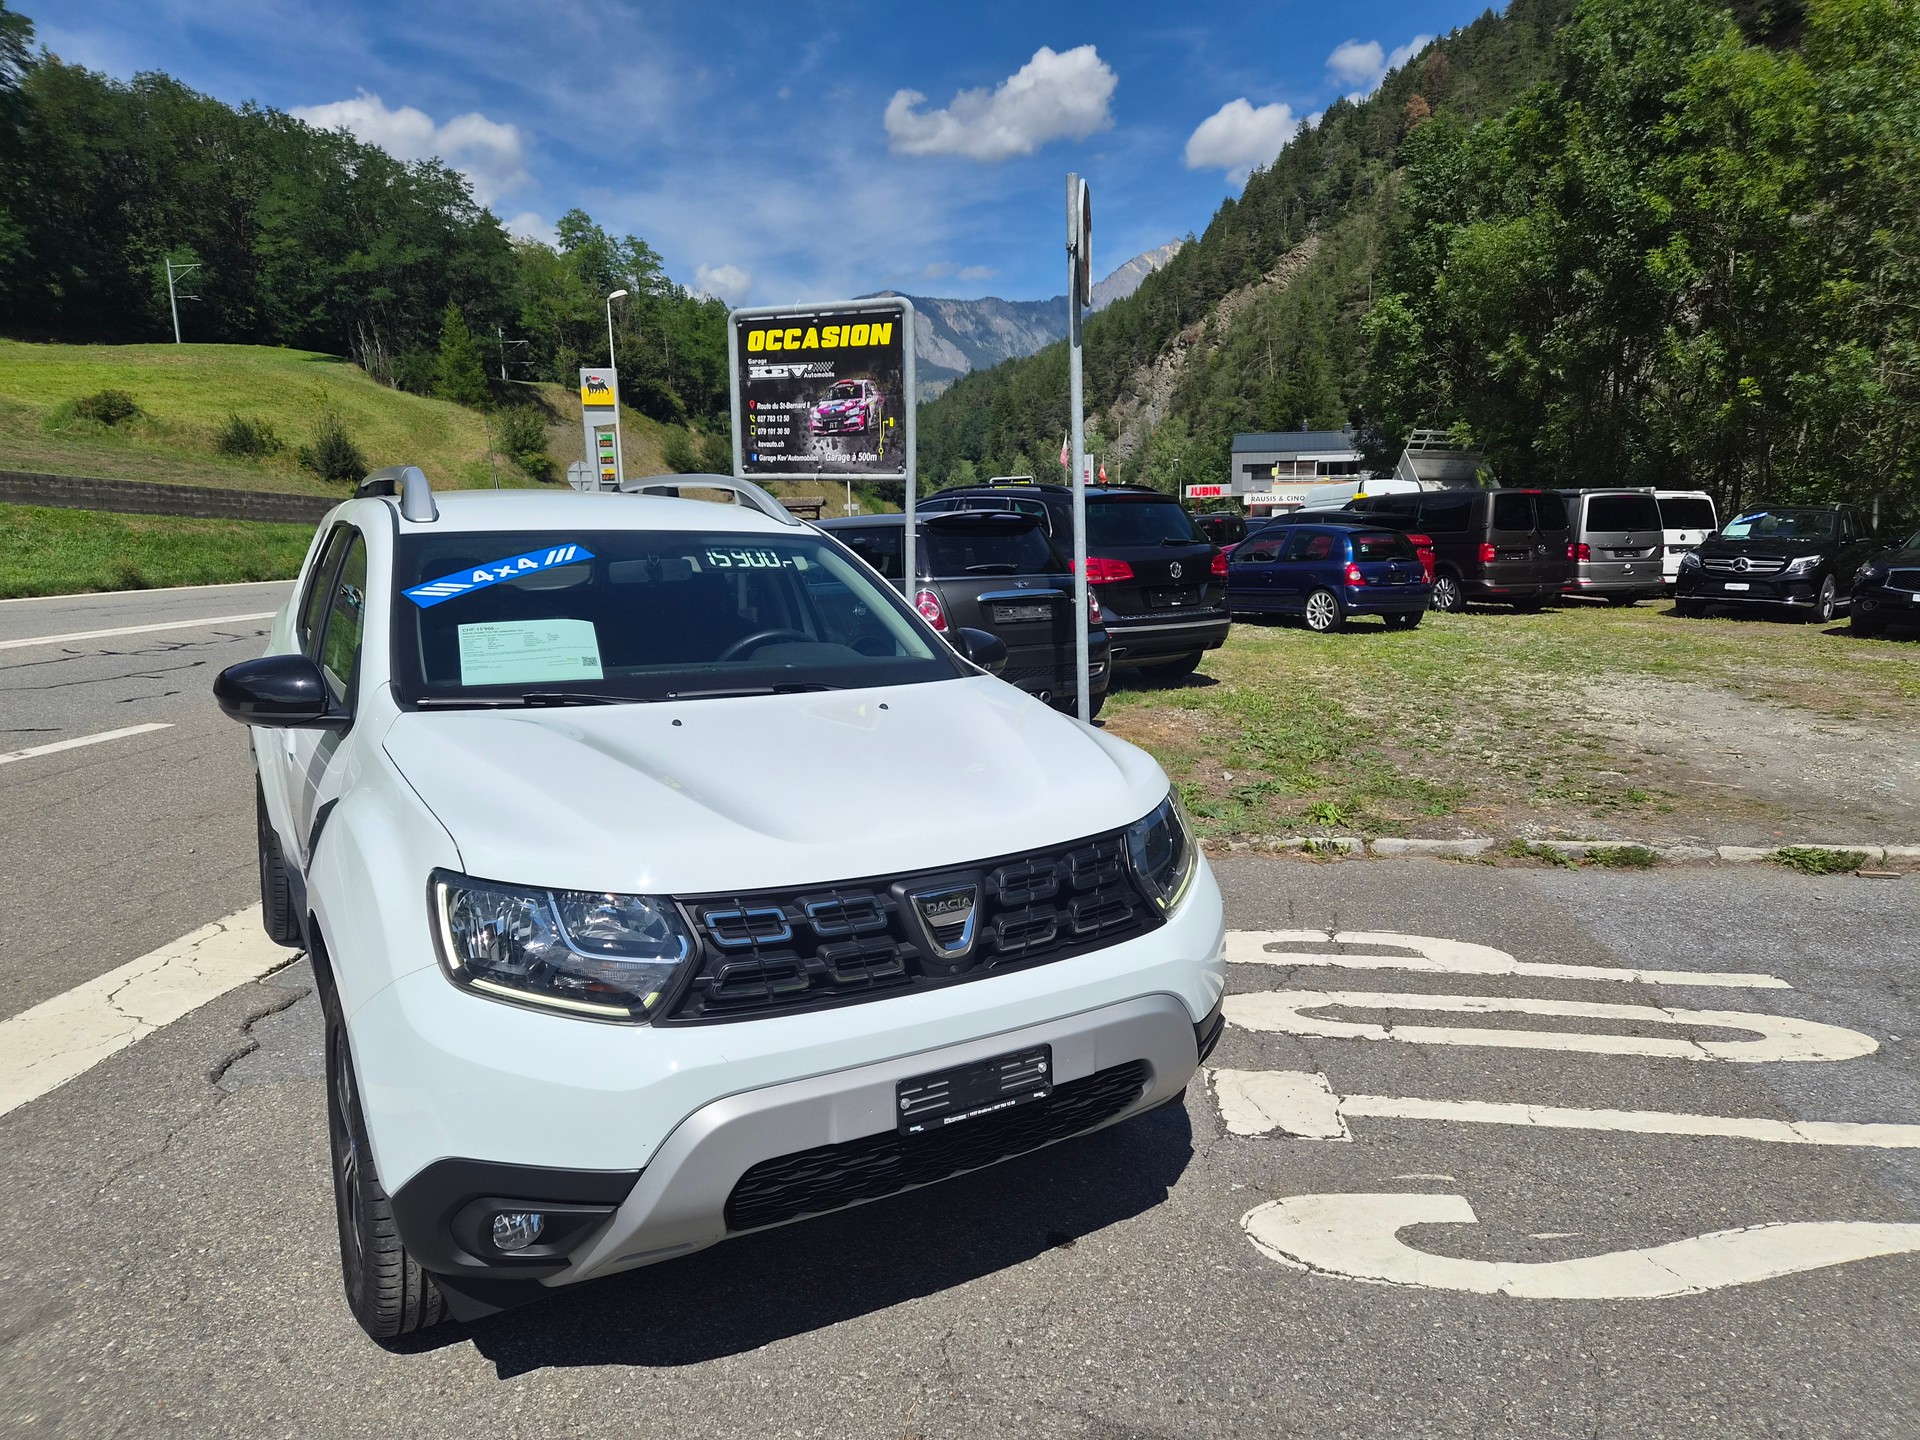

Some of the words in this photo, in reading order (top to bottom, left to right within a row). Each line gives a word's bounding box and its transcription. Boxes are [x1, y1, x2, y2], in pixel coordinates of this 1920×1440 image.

[747, 322, 893, 352] OCCASION
[756, 402, 771, 410] Route
[772, 402, 779, 410] du
[780, 401, 807, 410] St-Bernard
[757, 415, 767, 423] 027
[776, 414, 783, 422] 12
[783, 414, 790, 422] 50
[759, 454, 777, 463] Garage
[825, 452, 850, 463] Garage
[851, 452, 857, 461] à
[858, 451, 877, 461] 500m
[1190, 486, 1221, 496] JUBIN
[472, 557, 539, 583] 4x4
[926, 897, 972, 914] DACIA
